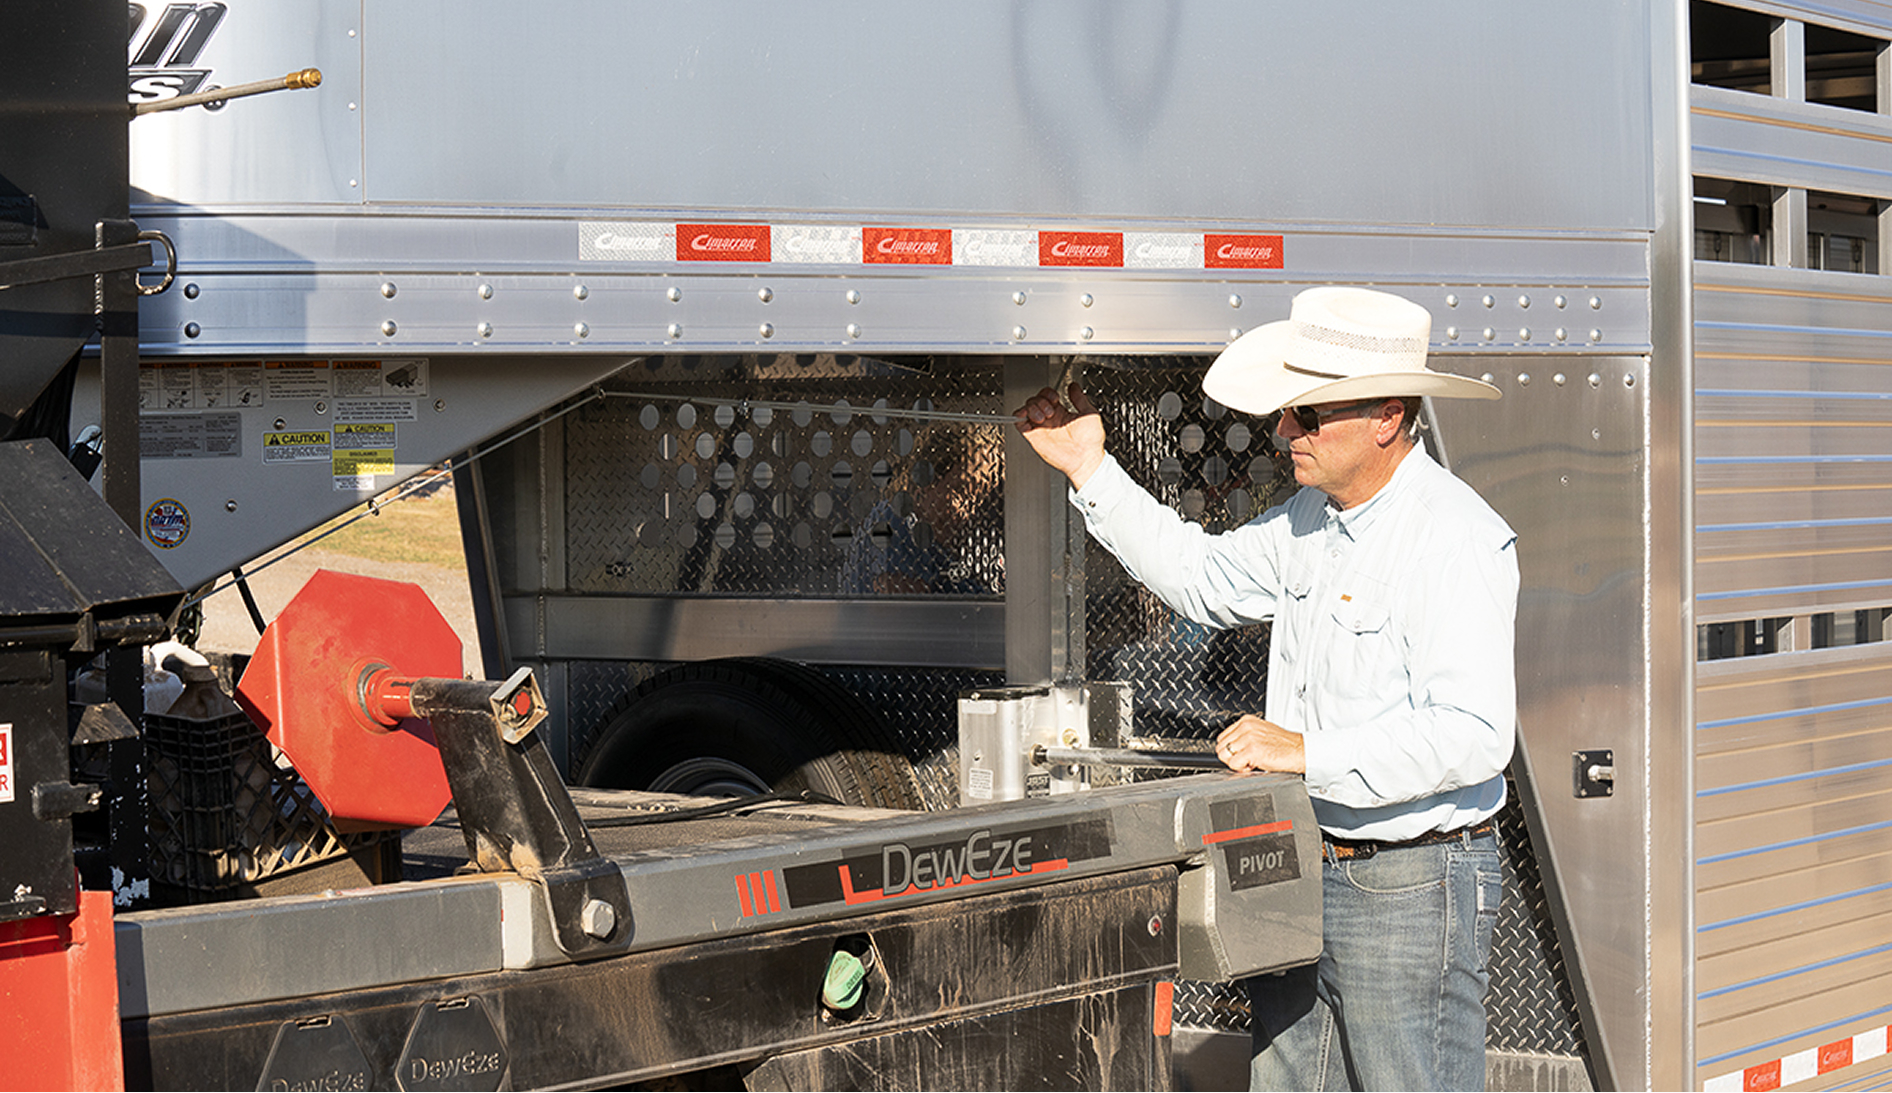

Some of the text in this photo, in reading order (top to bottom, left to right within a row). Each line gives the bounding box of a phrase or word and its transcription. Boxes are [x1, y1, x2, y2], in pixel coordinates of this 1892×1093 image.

[691, 234, 757, 251] Cimarron
[877, 237, 939, 254] Cimarron
[354, 425, 385, 433] CAUTION
[281, 433, 325, 444] CAUTION
[1239, 850, 1285, 876] PIVOT
